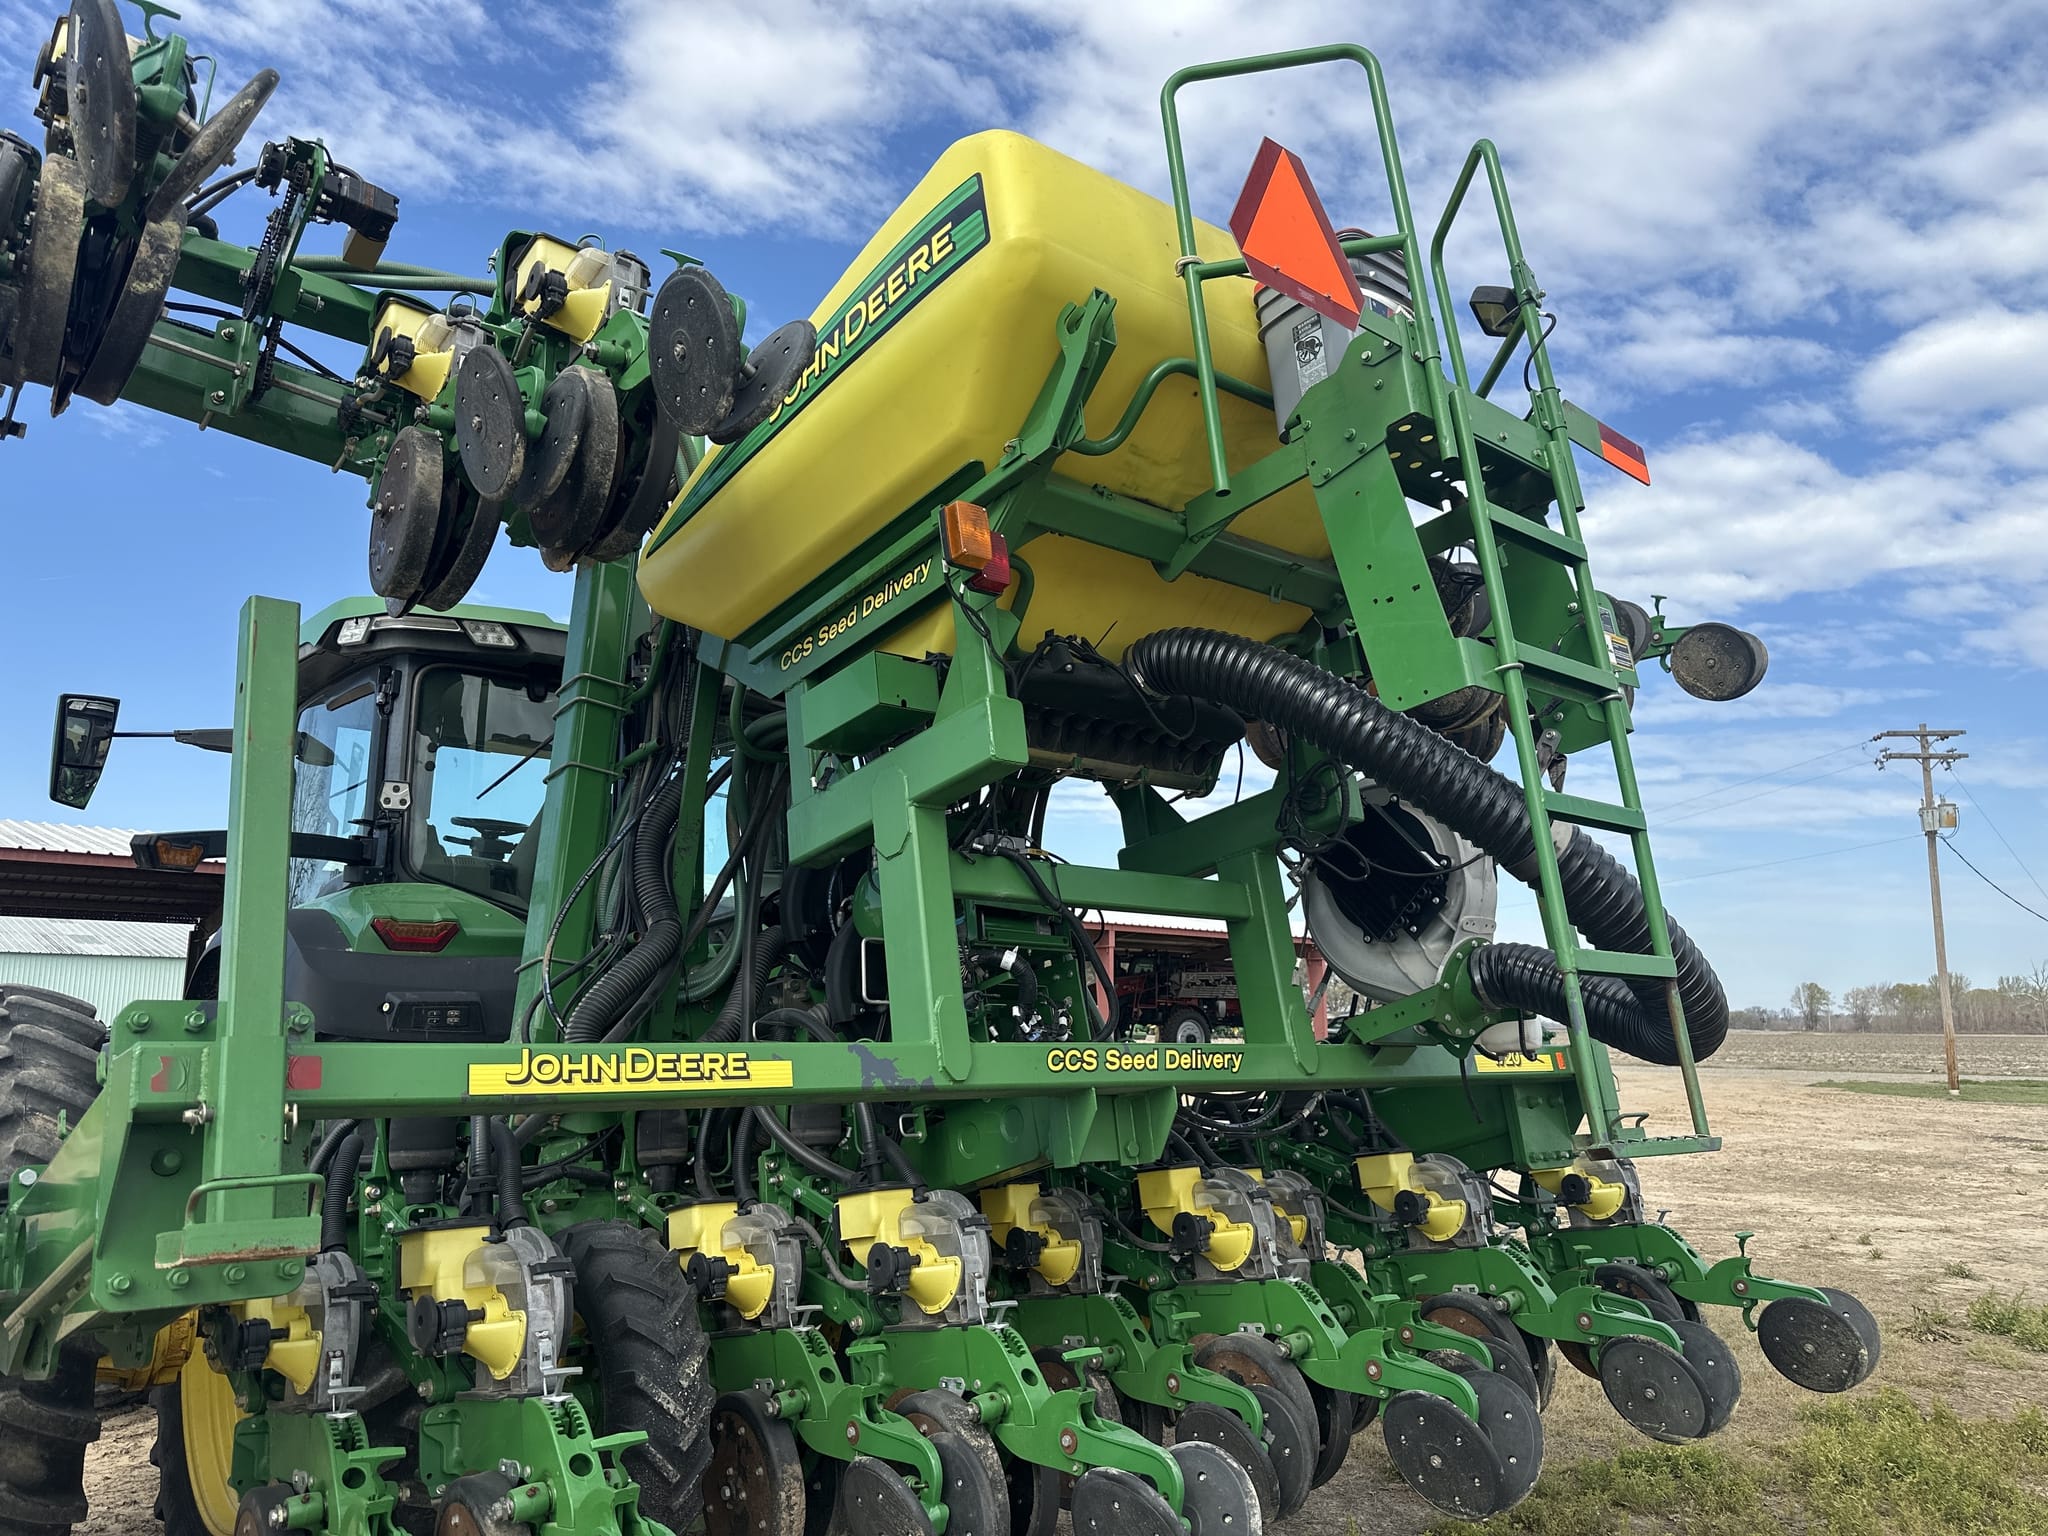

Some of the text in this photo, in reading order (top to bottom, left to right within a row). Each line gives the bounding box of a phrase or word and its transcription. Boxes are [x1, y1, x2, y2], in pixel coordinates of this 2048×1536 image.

[844, 221, 955, 348] DEERE
[780, 556, 933, 671] CCS Seed Delivery
[505, 1047, 751, 1085] JOHN DEERE
[1047, 1047, 1244, 1073] CCS Seed Delivery
